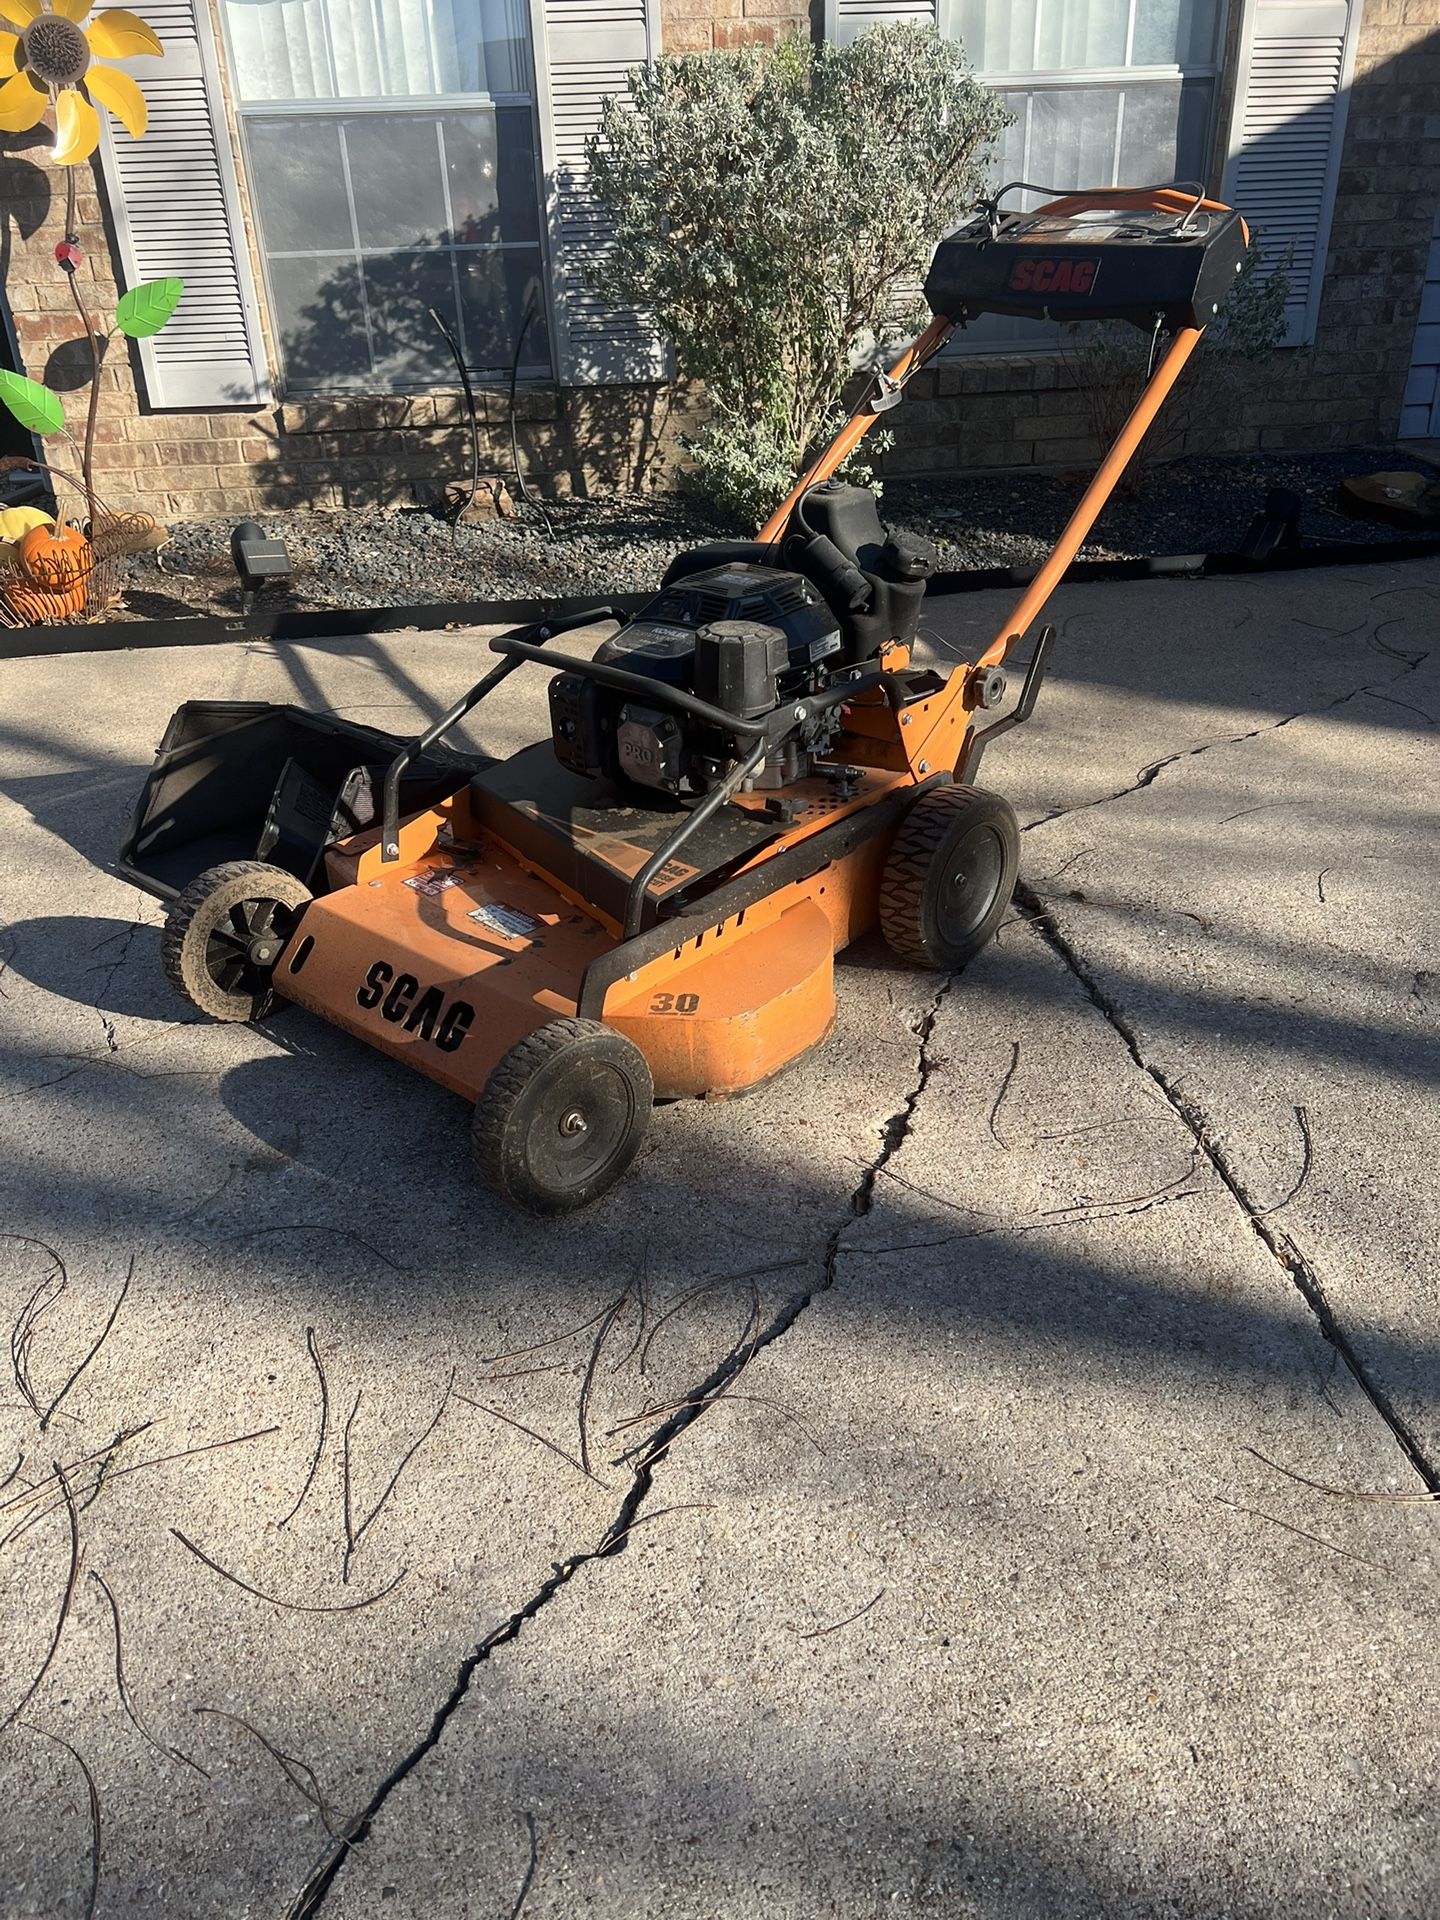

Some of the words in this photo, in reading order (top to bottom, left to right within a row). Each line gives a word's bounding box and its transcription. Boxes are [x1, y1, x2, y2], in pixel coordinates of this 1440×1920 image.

[1011, 260, 1095, 291] SCAG
[624, 742, 652, 765] PRO
[663, 863, 689, 876] CAG
[356, 960, 476, 1053] SCAG
[650, 993, 700, 1012] 30
